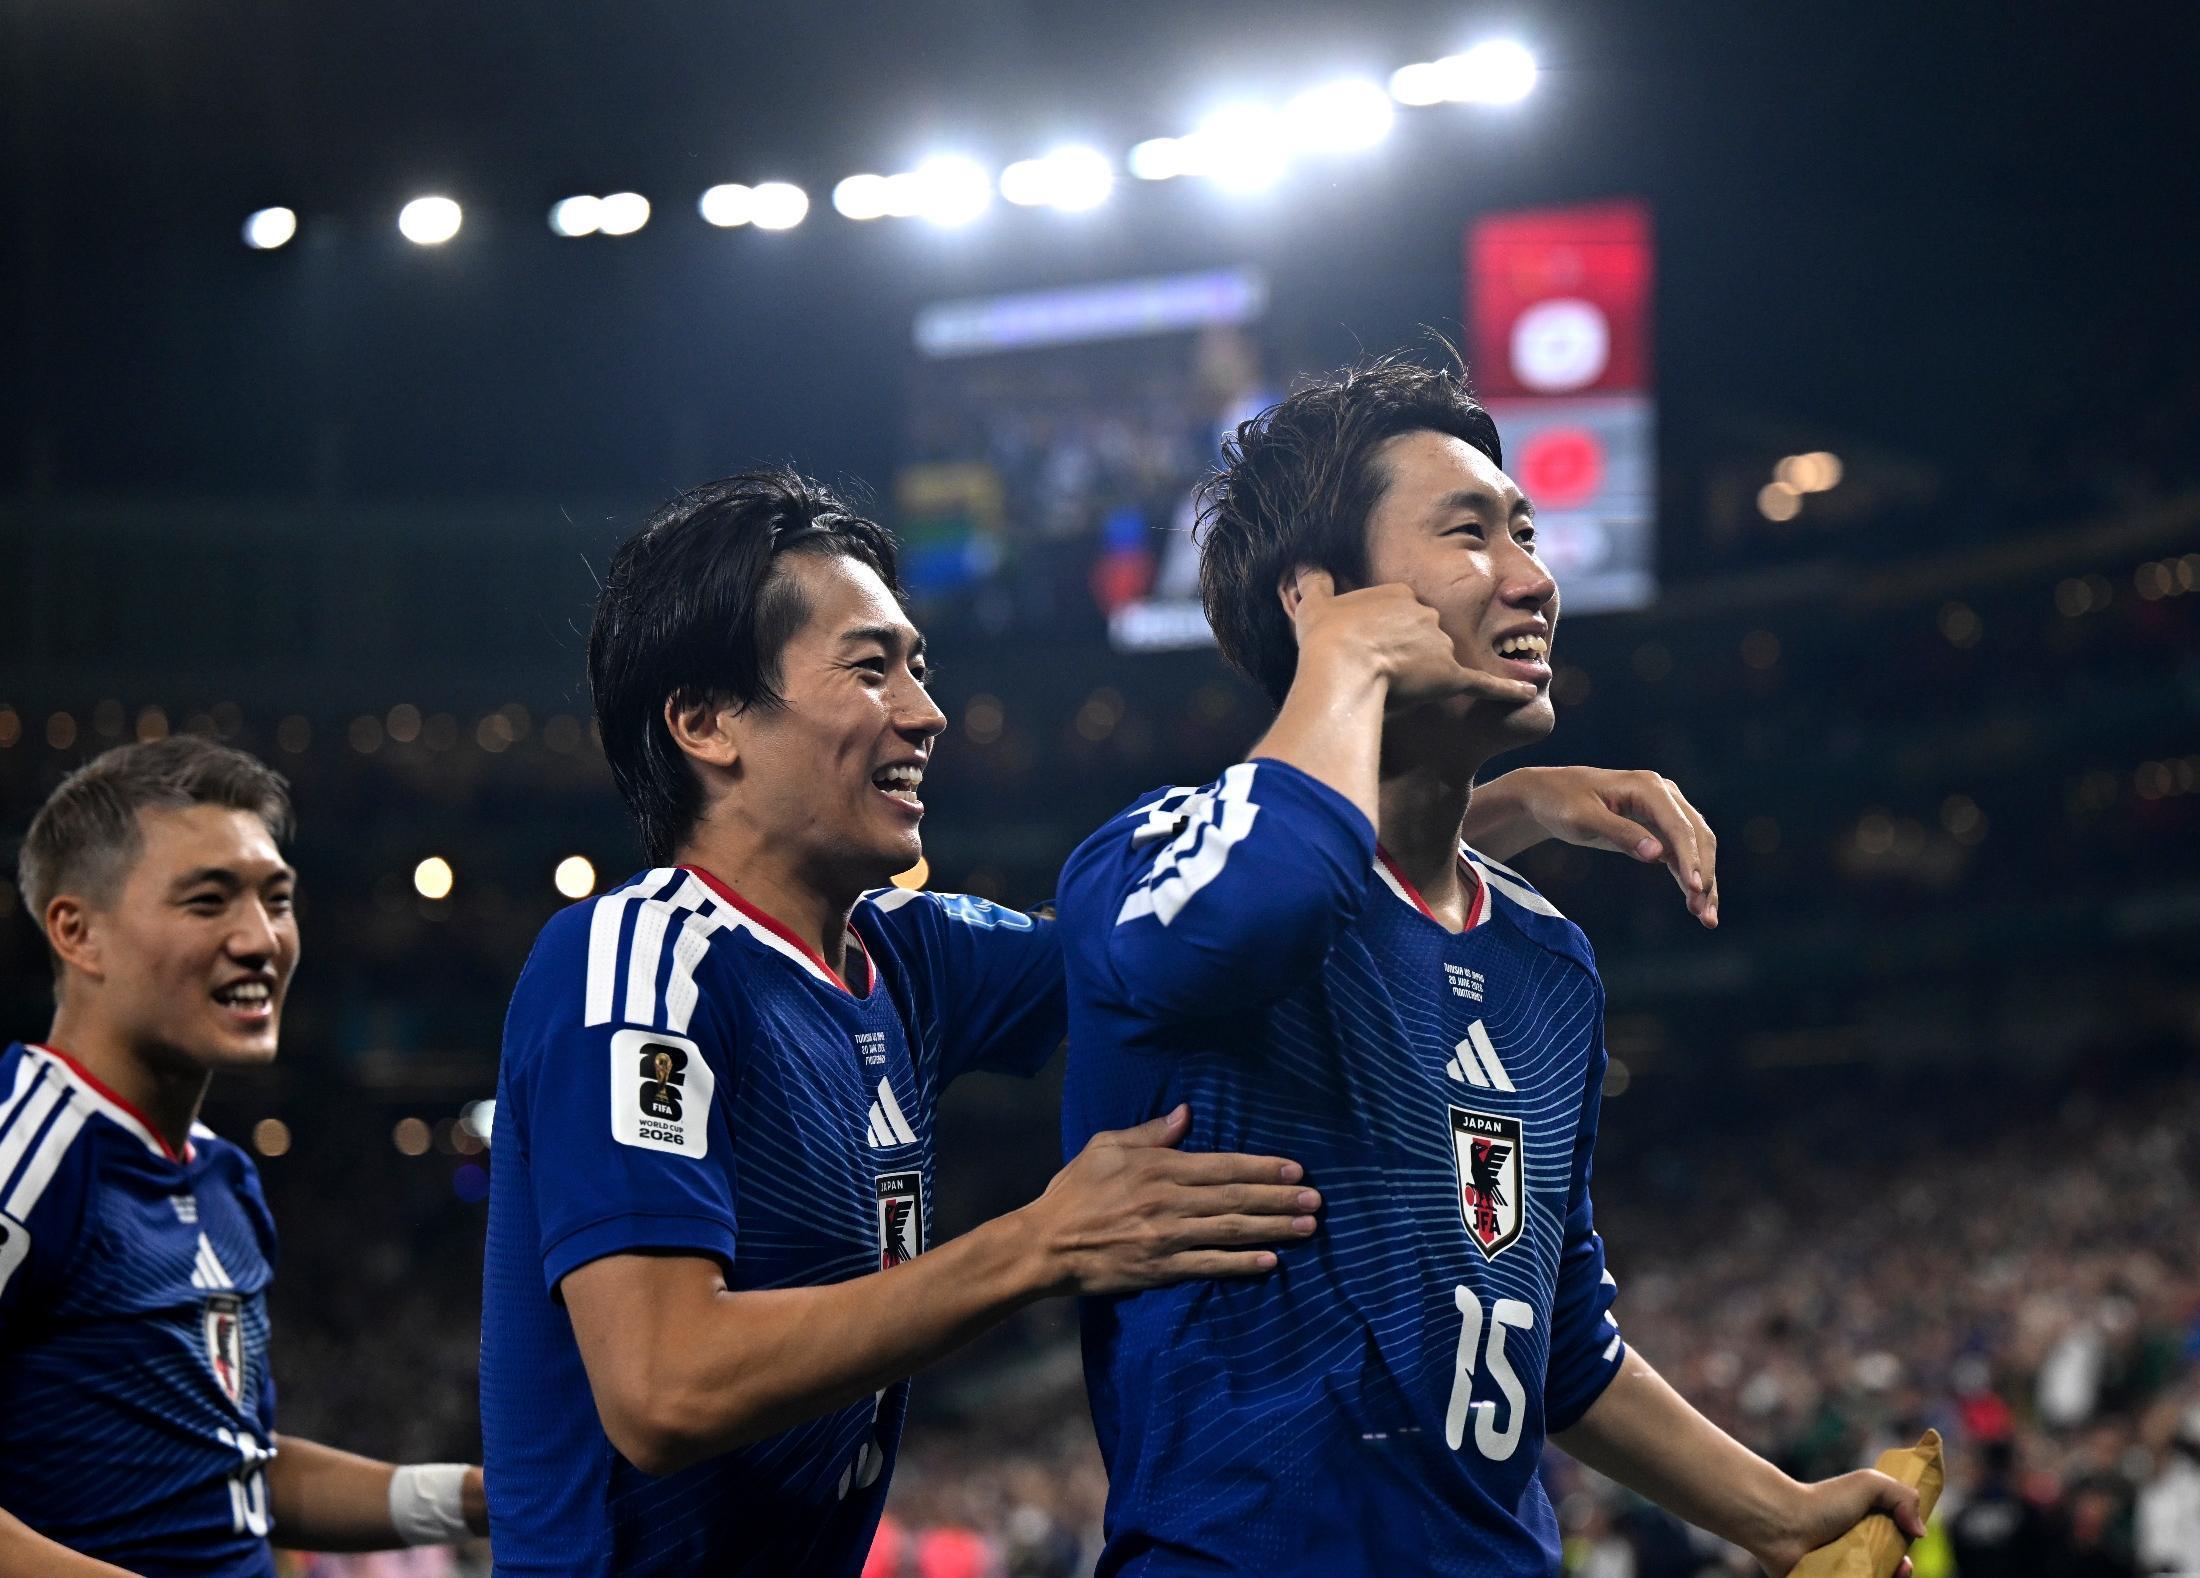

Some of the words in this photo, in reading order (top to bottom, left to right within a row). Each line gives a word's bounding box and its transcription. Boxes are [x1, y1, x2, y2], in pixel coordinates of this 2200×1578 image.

[652, 1102, 673, 1115] FIFA
[639, 1119, 669, 1130] WORLD
[669, 1124, 684, 1133] CUP
[1462, 1116, 1502, 1133] JAPAN
[639, 1127, 685, 1146] 2026
[881, 1179, 904, 1192] JAPAN
[1472, 1208, 1502, 1236] JFA
[1445, 1284, 1534, 1462] 15
